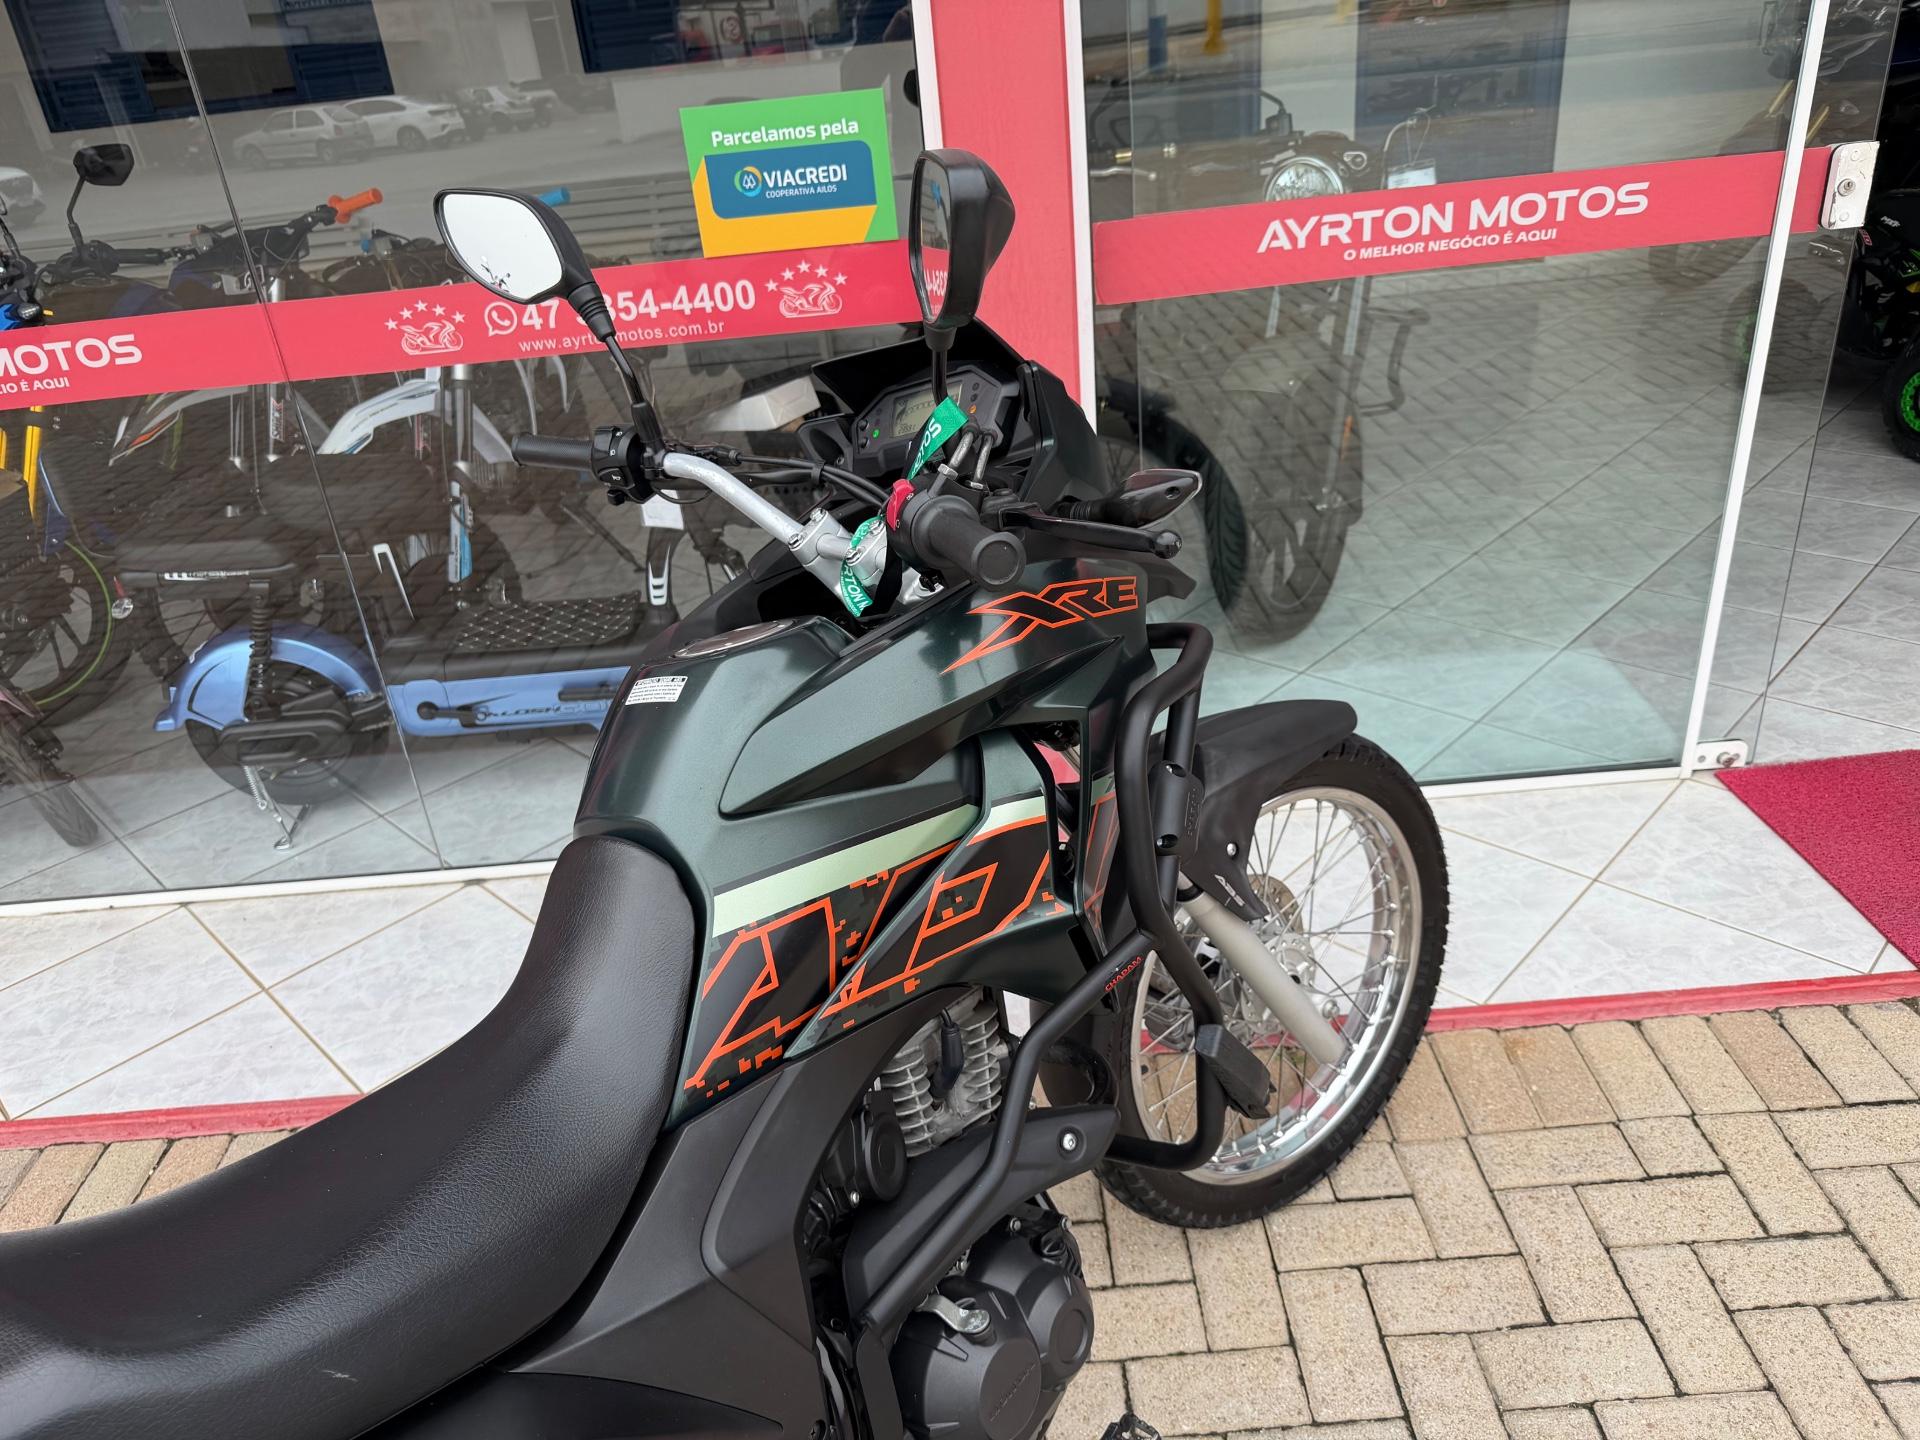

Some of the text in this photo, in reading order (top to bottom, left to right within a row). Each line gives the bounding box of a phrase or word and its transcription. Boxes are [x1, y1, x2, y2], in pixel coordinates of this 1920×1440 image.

[711, 118, 859, 147] Parcelamos pela
[763, 164, 848, 188] VIACREDI
[765, 184, 837, 199] COOPERATIVA AILOS
[1257, 181, 1650, 254] AYRTON MOTOS
[1343, 227, 1557, 261] O MELHOR NEGÓCIO É AQUI
[521, 279, 756, 331] 47 354-4400
[518, 319, 725, 353] www.ayrtmotos.com.br
[20, 379, 31, 392] É
[33, 377, 70, 391] AQUI
[843, 563, 866, 602] RTON
[939, 575, 1139, 675] XRE
